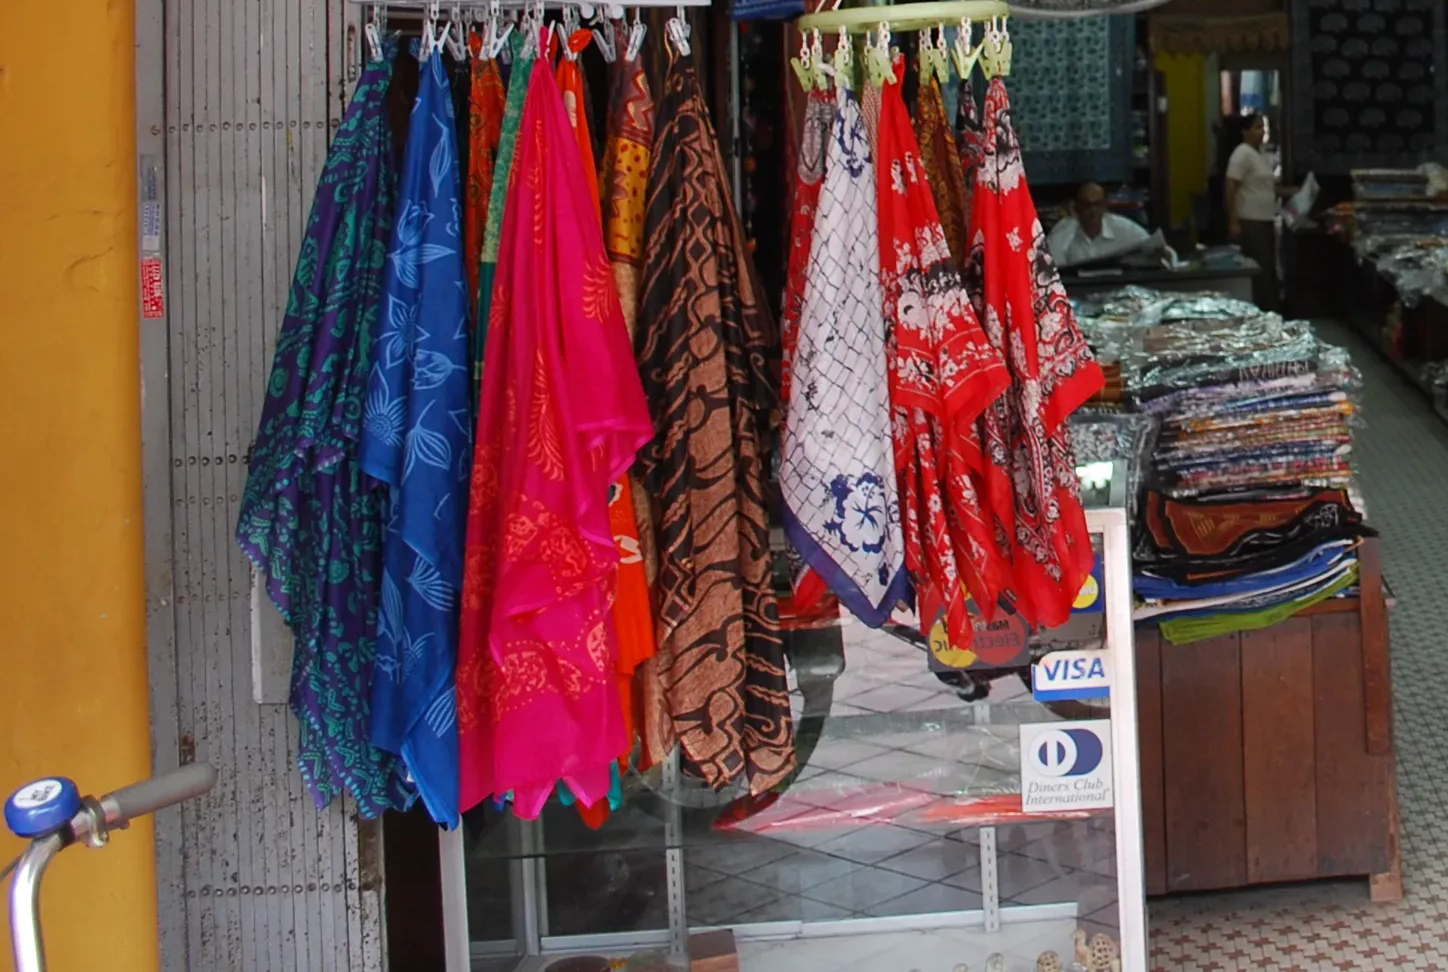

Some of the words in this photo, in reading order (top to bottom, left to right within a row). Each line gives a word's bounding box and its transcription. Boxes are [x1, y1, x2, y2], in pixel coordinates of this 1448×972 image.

[1043, 657, 1105, 682] VISA
[1027, 781, 1069, 794] Diners
[1073, 778, 1104, 791] Club
[1025, 789, 1107, 806] International
